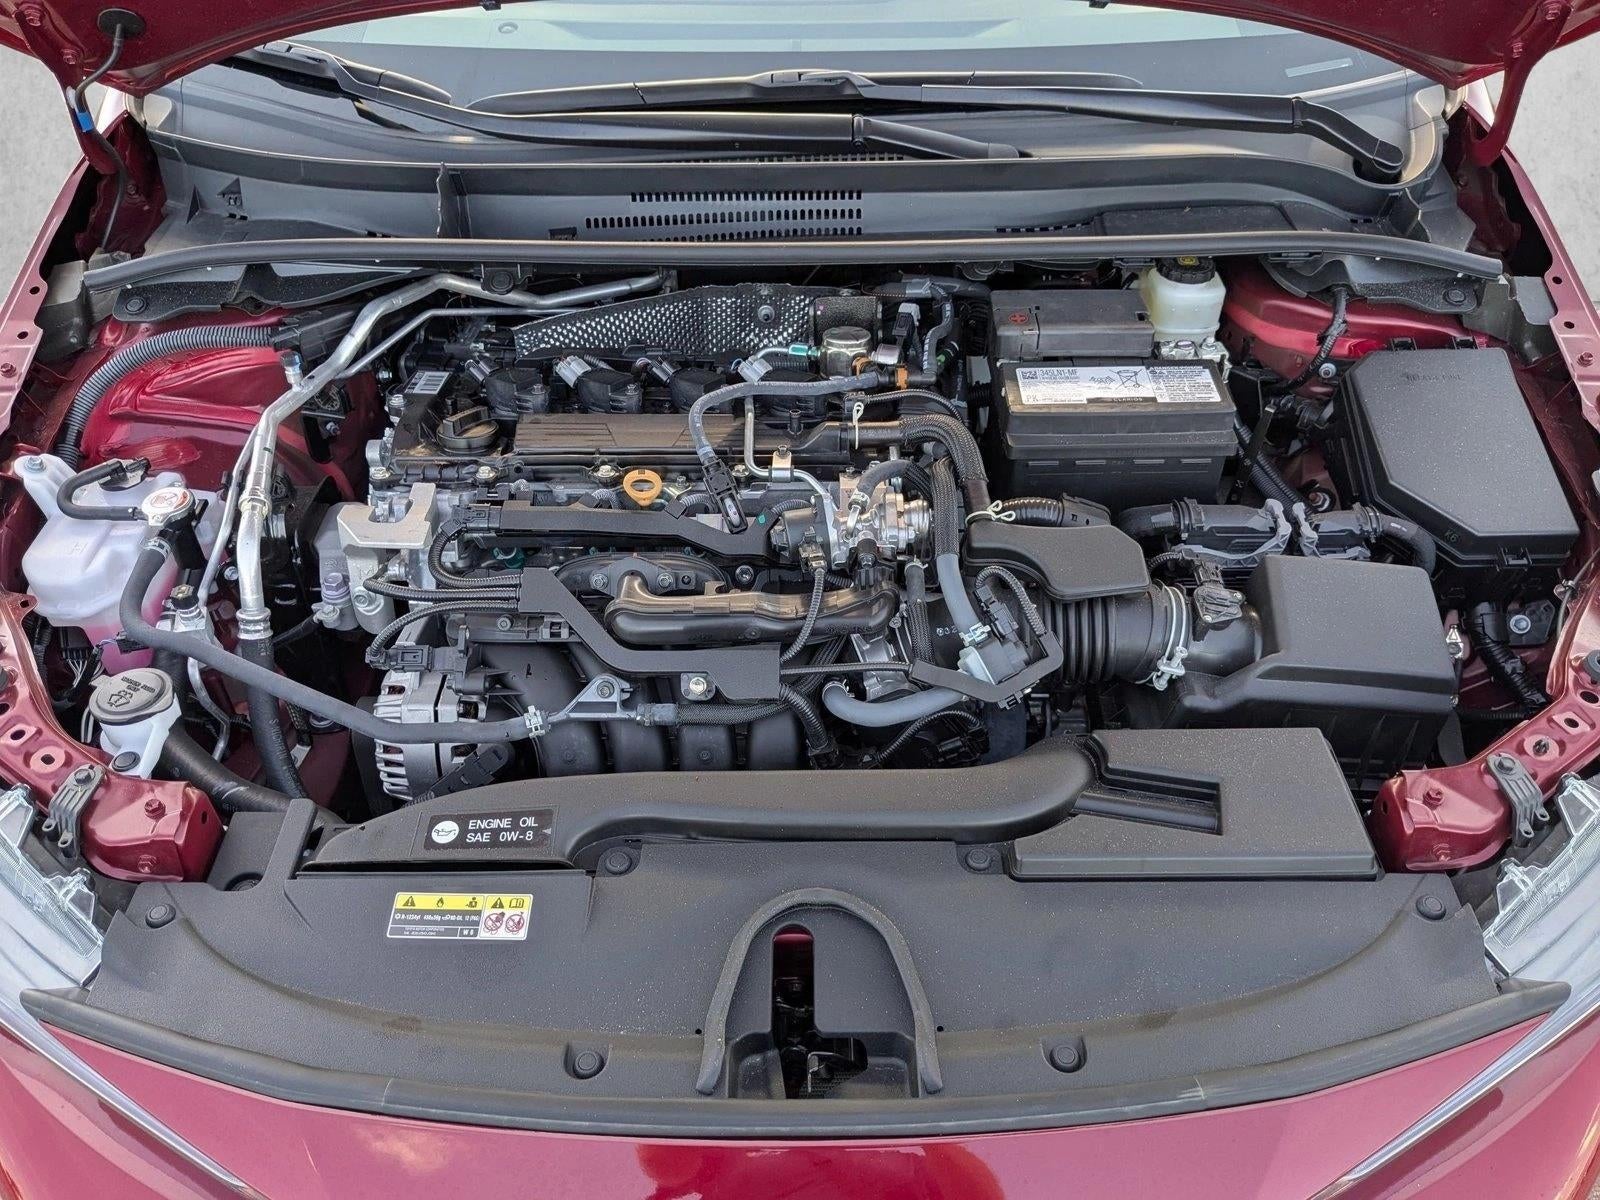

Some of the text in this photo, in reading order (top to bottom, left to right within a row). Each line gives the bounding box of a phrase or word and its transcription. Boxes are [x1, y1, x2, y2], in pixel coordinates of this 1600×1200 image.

[468, 816, 539, 829] ENGINE OIL
[465, 830, 534, 842] SAE 0W-8
